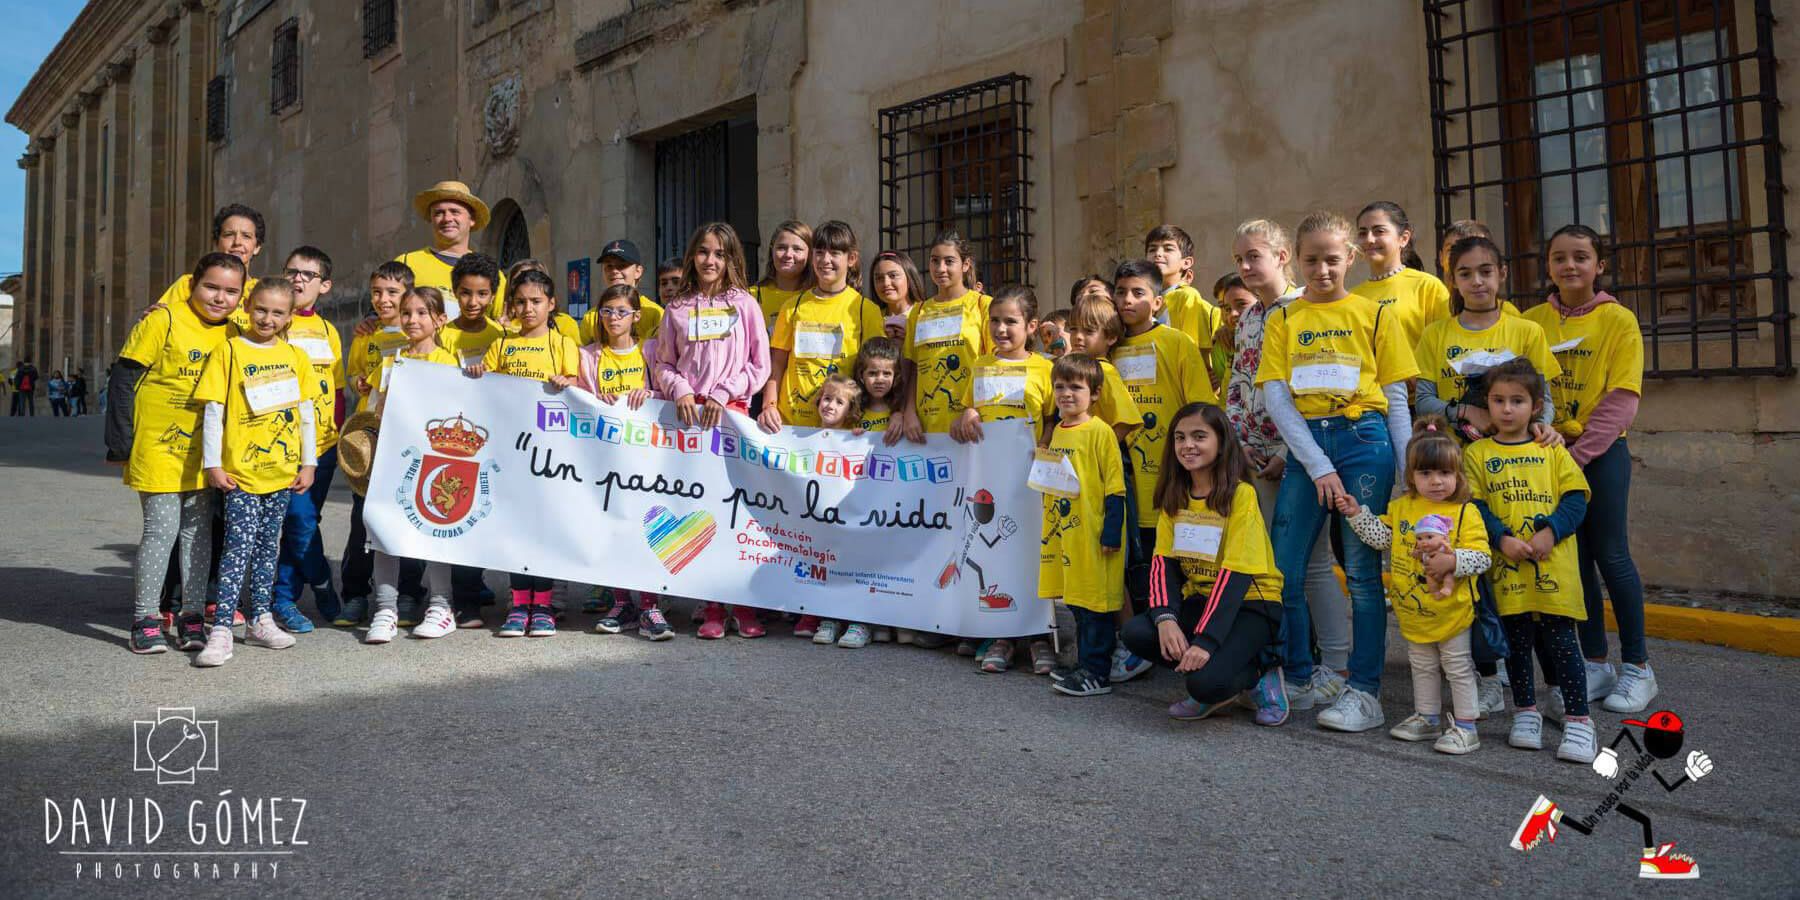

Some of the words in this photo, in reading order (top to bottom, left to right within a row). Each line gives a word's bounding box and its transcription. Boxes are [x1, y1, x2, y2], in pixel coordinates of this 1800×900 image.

[543, 406, 700, 450] Marcha
[718, 434, 950, 481] Solidaria
[1486, 457, 1545, 473] PANTANY
[1487, 477, 1528, 493] Marcha
[596, 471, 704, 511] paseo
[722, 484, 789, 529] por
[800, 479, 846, 524] la
[1503, 489, 1552, 504] Solidaria
[432, 527, 463, 538] CIUDAD
[745, 518, 812, 542] Fundación
[739, 550, 793, 567] Infantil
